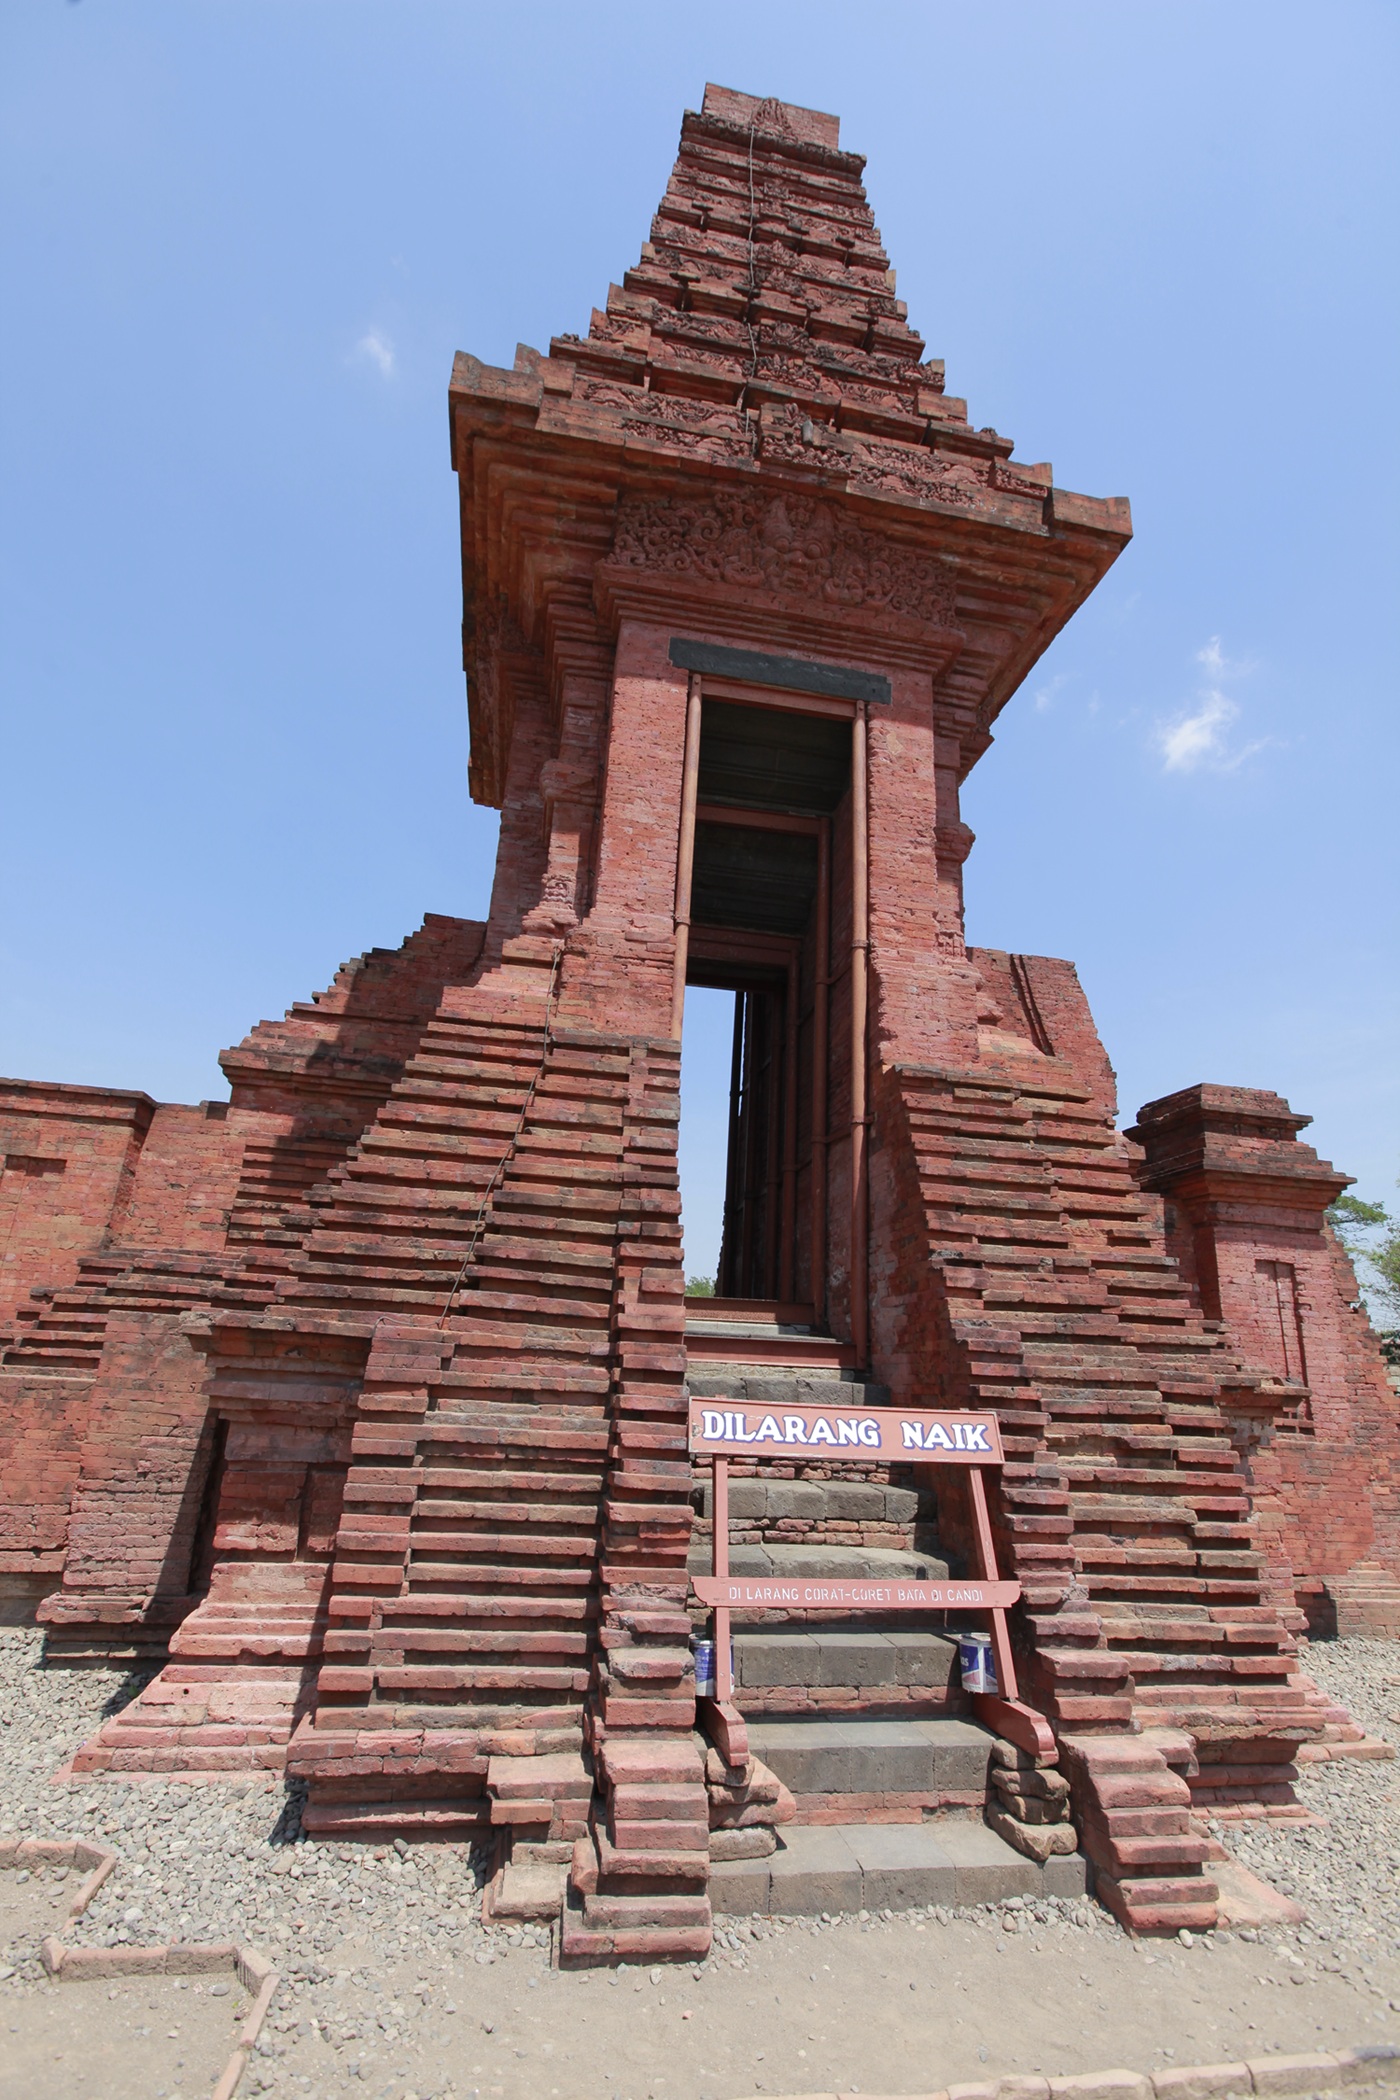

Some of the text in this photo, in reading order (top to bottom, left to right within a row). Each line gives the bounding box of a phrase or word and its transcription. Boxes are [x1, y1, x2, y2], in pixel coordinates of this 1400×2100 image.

[701, 1410, 992, 1450] DILARANG NAIK
[729, 1587, 984, 1602] DI LARANG CORAT-CORET BATA DI CANDI
